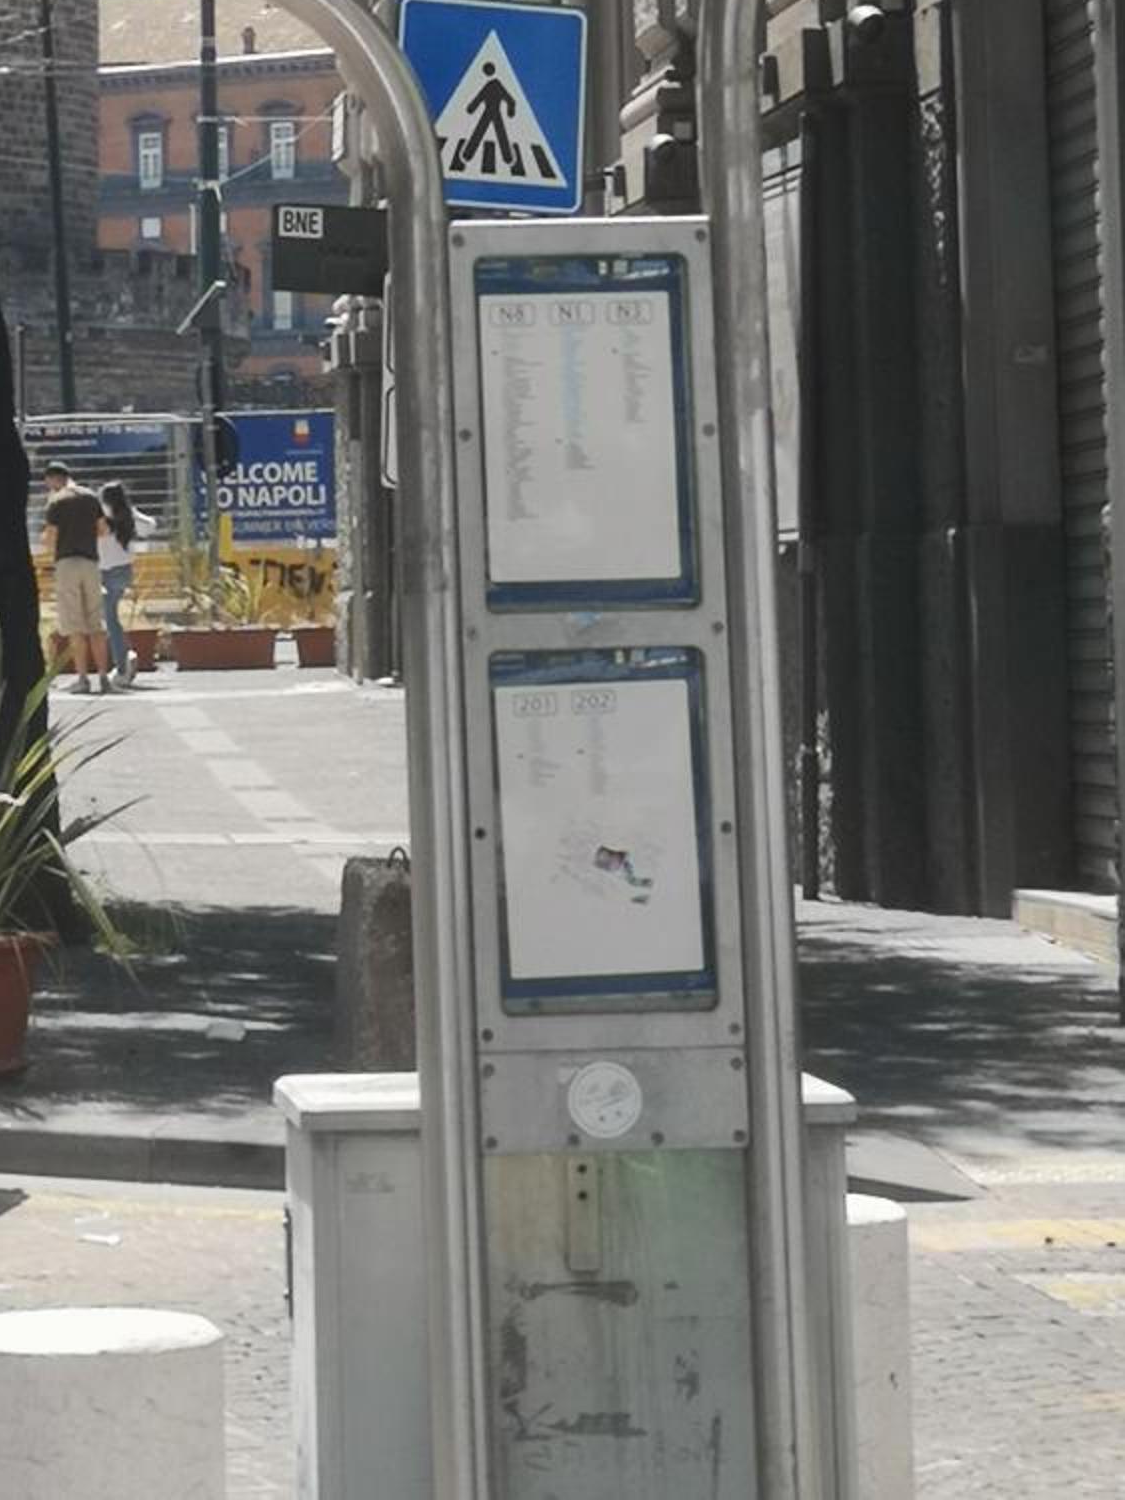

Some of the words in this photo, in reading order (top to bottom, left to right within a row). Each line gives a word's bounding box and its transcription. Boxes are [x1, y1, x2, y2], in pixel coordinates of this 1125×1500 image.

[281, 209, 321, 235] BNE
[201, 461, 319, 485] ELCOME
[238, 484, 326, 507] NAPOLI
